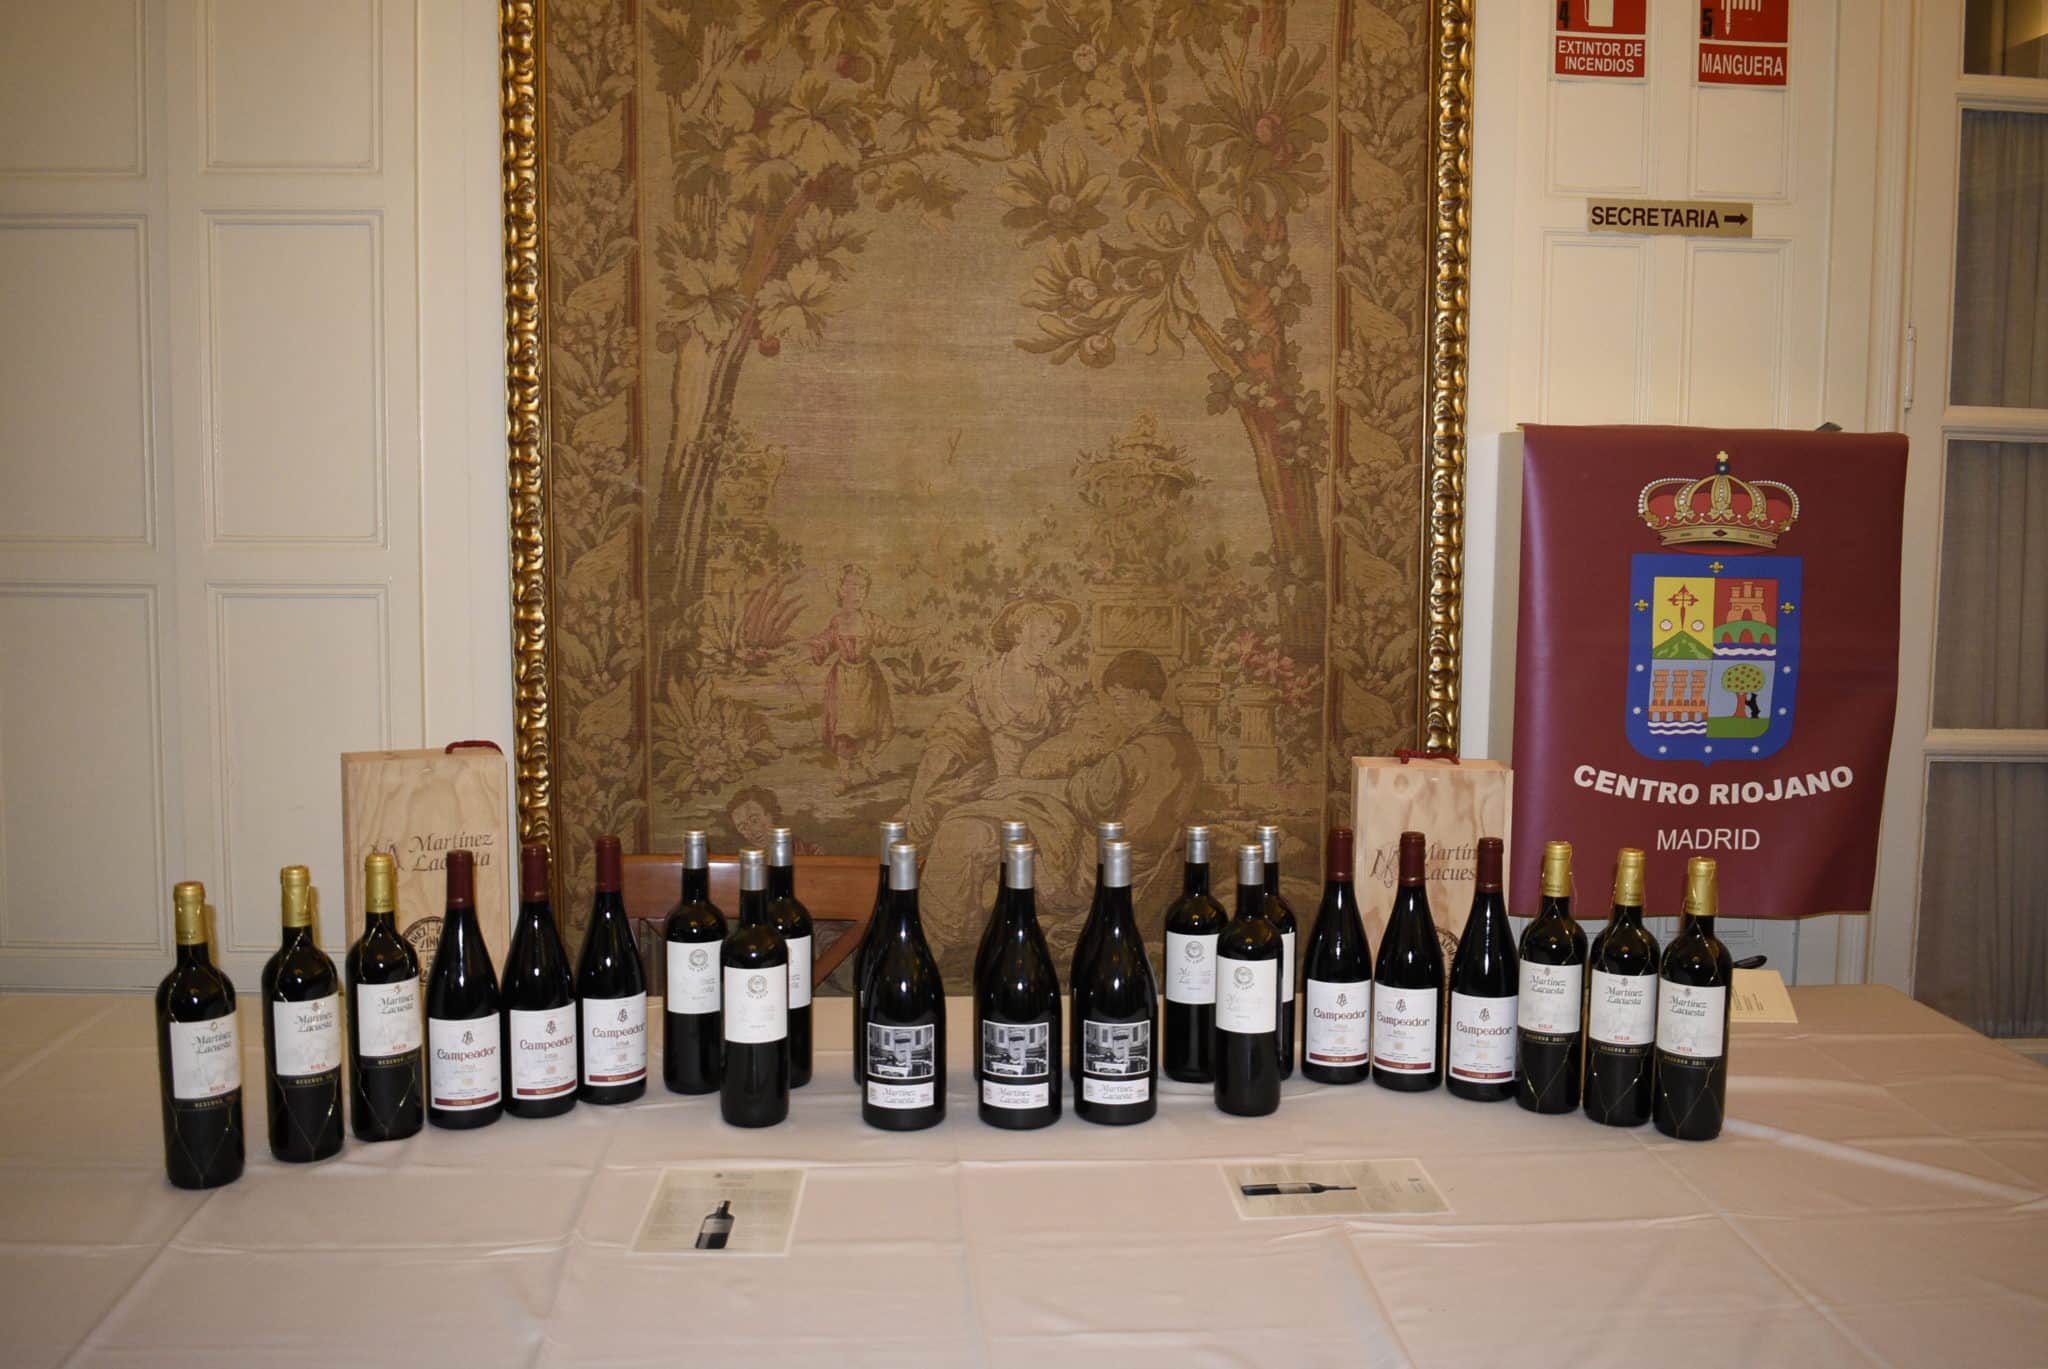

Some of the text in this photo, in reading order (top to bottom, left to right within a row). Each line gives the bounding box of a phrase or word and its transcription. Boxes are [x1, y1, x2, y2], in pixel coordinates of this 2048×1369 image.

[1702, 8, 1713, 38] 5
[1558, 40, 1643, 57] EXTINTOR DE
[1564, 56, 1635, 73] INCENDIOS
[1701, 53, 1784, 77] MANGUERA
[1591, 206, 1719, 229] SECRETARIA
[1573, 764, 1853, 805] CENTRO RIOJANO
[1656, 828, 1760, 851] MADRID
[1313, 1007, 1368, 1022] Campeador
[1376, 1011, 1431, 1027] Campeador
[592, 1023, 646, 1040] Campeador
[1456, 1020, 1513, 1037] Campeador
[519, 1034, 575, 1051] Campeador
[436, 1046, 497, 1062] Campeador
